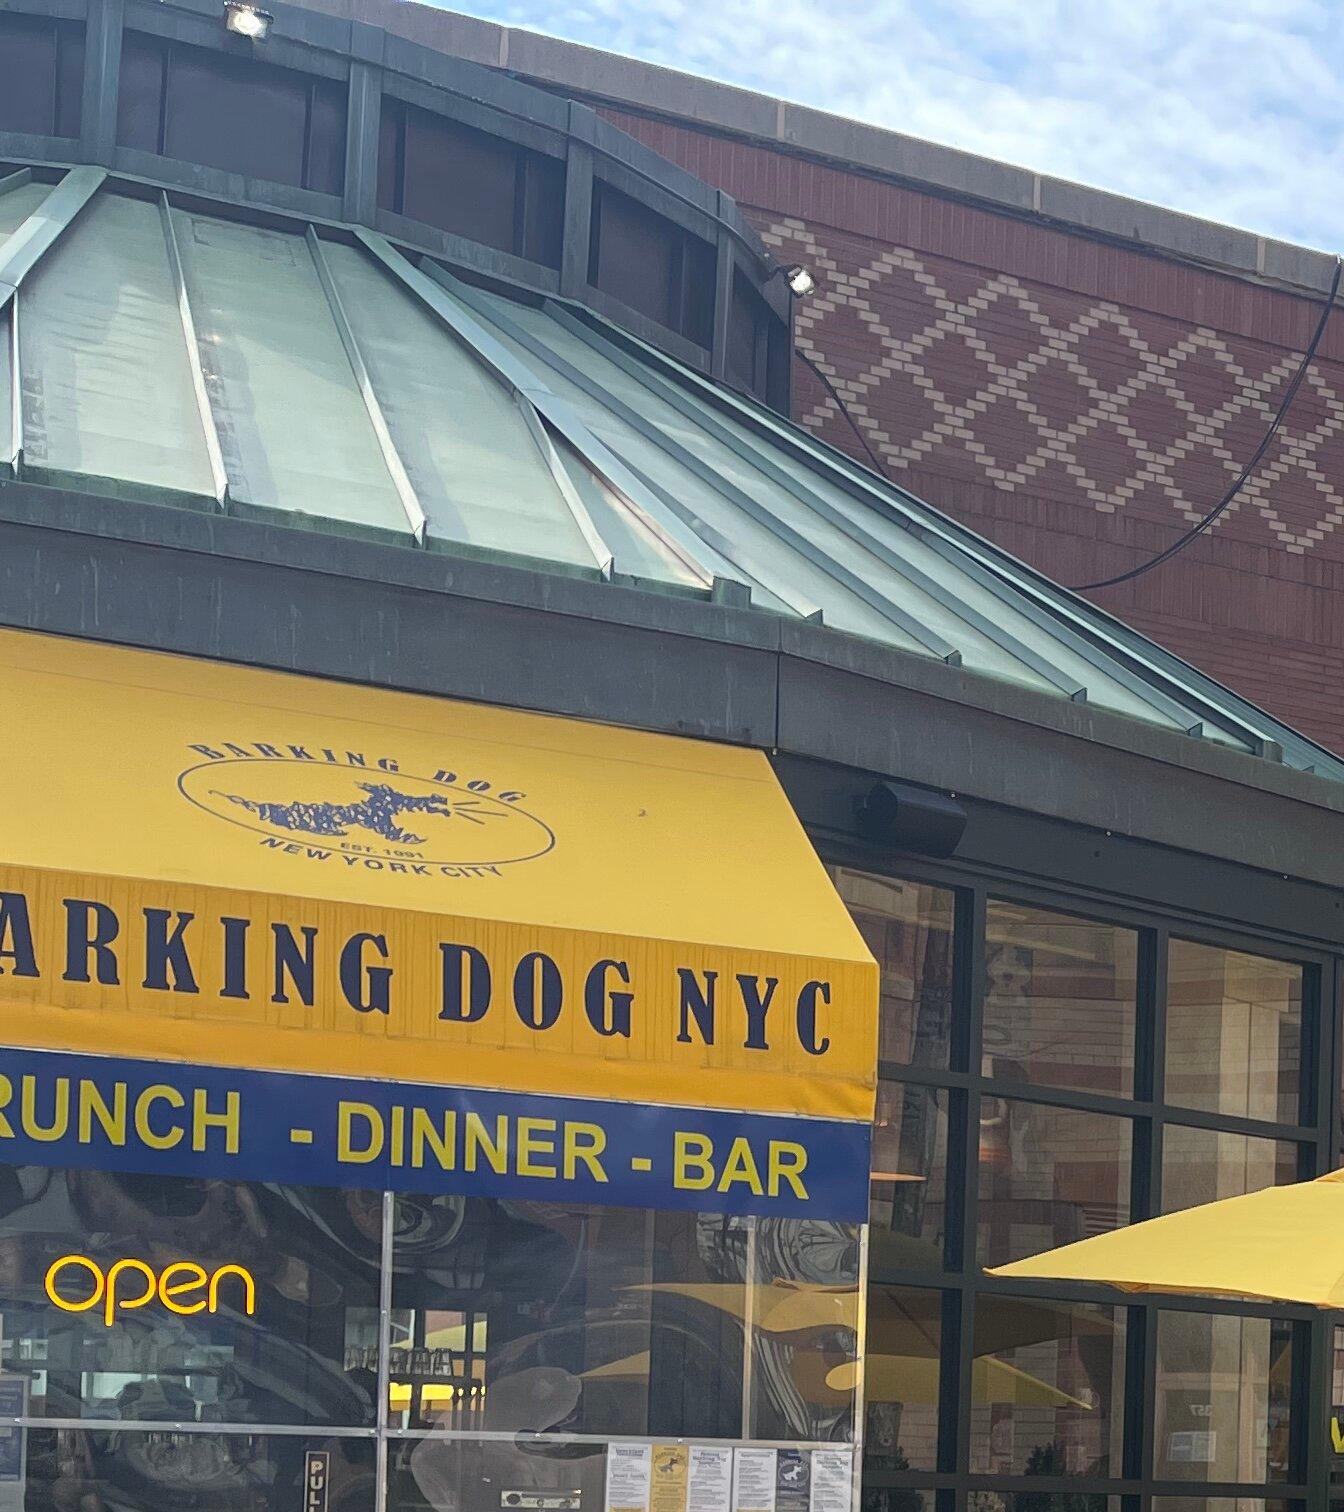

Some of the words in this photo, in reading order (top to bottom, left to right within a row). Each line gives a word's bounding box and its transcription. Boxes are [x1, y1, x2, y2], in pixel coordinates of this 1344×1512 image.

[187, 741, 400, 773] BARKING
[432, 768, 527, 802] DOG
[259, 837, 332, 861] NEW
[342, 854, 432, 877] YORK
[440, 865, 503, 878] CITY
[438, 942, 635, 1038] DOG
[677, 968, 832, 1056] NYC
[338, 1100, 609, 1183] DINNER
[673, 1131, 810, 1200] BAR
[45, 1254, 255, 1327] open
